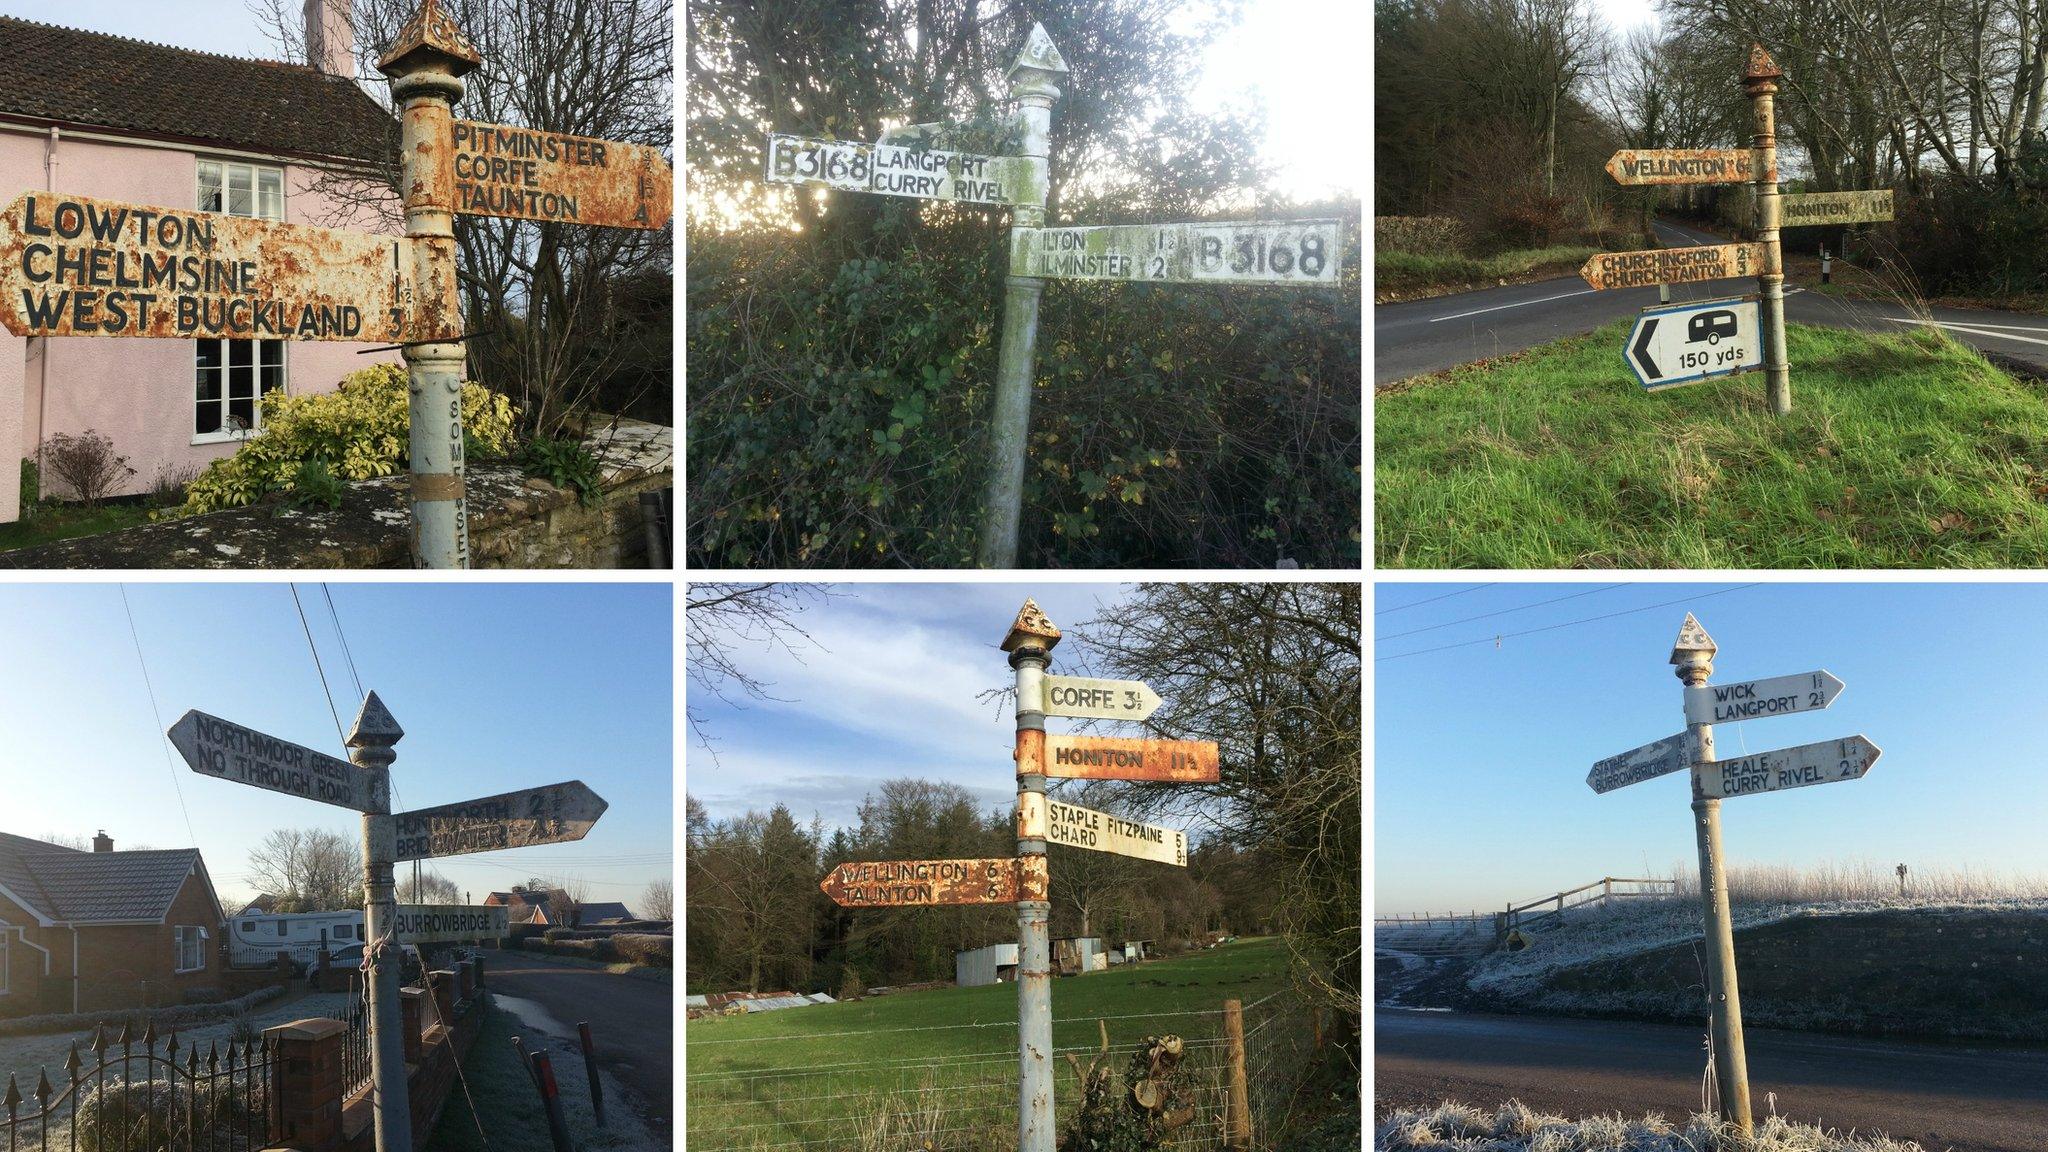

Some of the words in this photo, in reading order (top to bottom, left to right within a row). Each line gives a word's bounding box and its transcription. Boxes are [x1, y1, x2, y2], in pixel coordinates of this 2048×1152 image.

[454, 123, 606, 168] PITMINSTER
[455, 152, 539, 187] CORFE
[775, 142, 869, 182] B3168
[876, 147, 989, 178] LANGPORT
[1622, 159, 1726, 177] WELLINGTON
[456, 182, 579, 220] TAUNTON
[874, 173, 944, 197] CURRY
[953, 180, 1008, 202] RIVEL
[1786, 202, 1850, 217] HONITON
[24, 196, 214, 252] LOWTON
[1042, 255, 1132, 277] ILMINSTER
[1043, 230, 1085, 251] ILTON
[1200, 231, 1325, 277] B3168
[1602, 250, 1720, 272] CHURCHINGFORD
[22, 244, 258, 295] CHELMSINE
[1602, 263, 1727, 288] CHURCHSTANTON
[22, 289, 157, 332] WEST
[177, 299, 361, 337] BUCKLAND
[1679, 351, 1709, 369] 150
[1717, 346, 1744, 365] yds
[1051, 686, 1115, 709] CORFE
[1715, 683, 1756, 703] WICK
[1715, 695, 1799, 721] LANGPORT
[196, 715, 304, 768] NORTHMOOR
[311, 753, 350, 782] GREEN
[1056, 747, 1143, 769] HONITON
[197, 743, 226, 774] NO
[236, 755, 311, 795] THROUGH
[319, 778, 350, 802] ROAD
[1596, 757, 1669, 791] BURROWBRIDGE
[1721, 756, 1768, 779] HEALE
[1723, 773, 1769, 795] CURRY
[1778, 765, 1824, 788] RIVEL
[1050, 804, 1099, 830] STAPLE
[1107, 818, 1163, 844] FITZPAINE
[1176, 833, 1182, 849] 5
[1050, 823, 1097, 847] CHARD
[396, 823, 508, 858] BRIDGWATER
[844, 863, 968, 881] WELLINGTON
[987, 863, 998, 878] 6
[843, 885, 932, 902] TAUNTON
[987, 884, 998, 900] 6
[397, 912, 491, 935] BURROWBRIDGE
